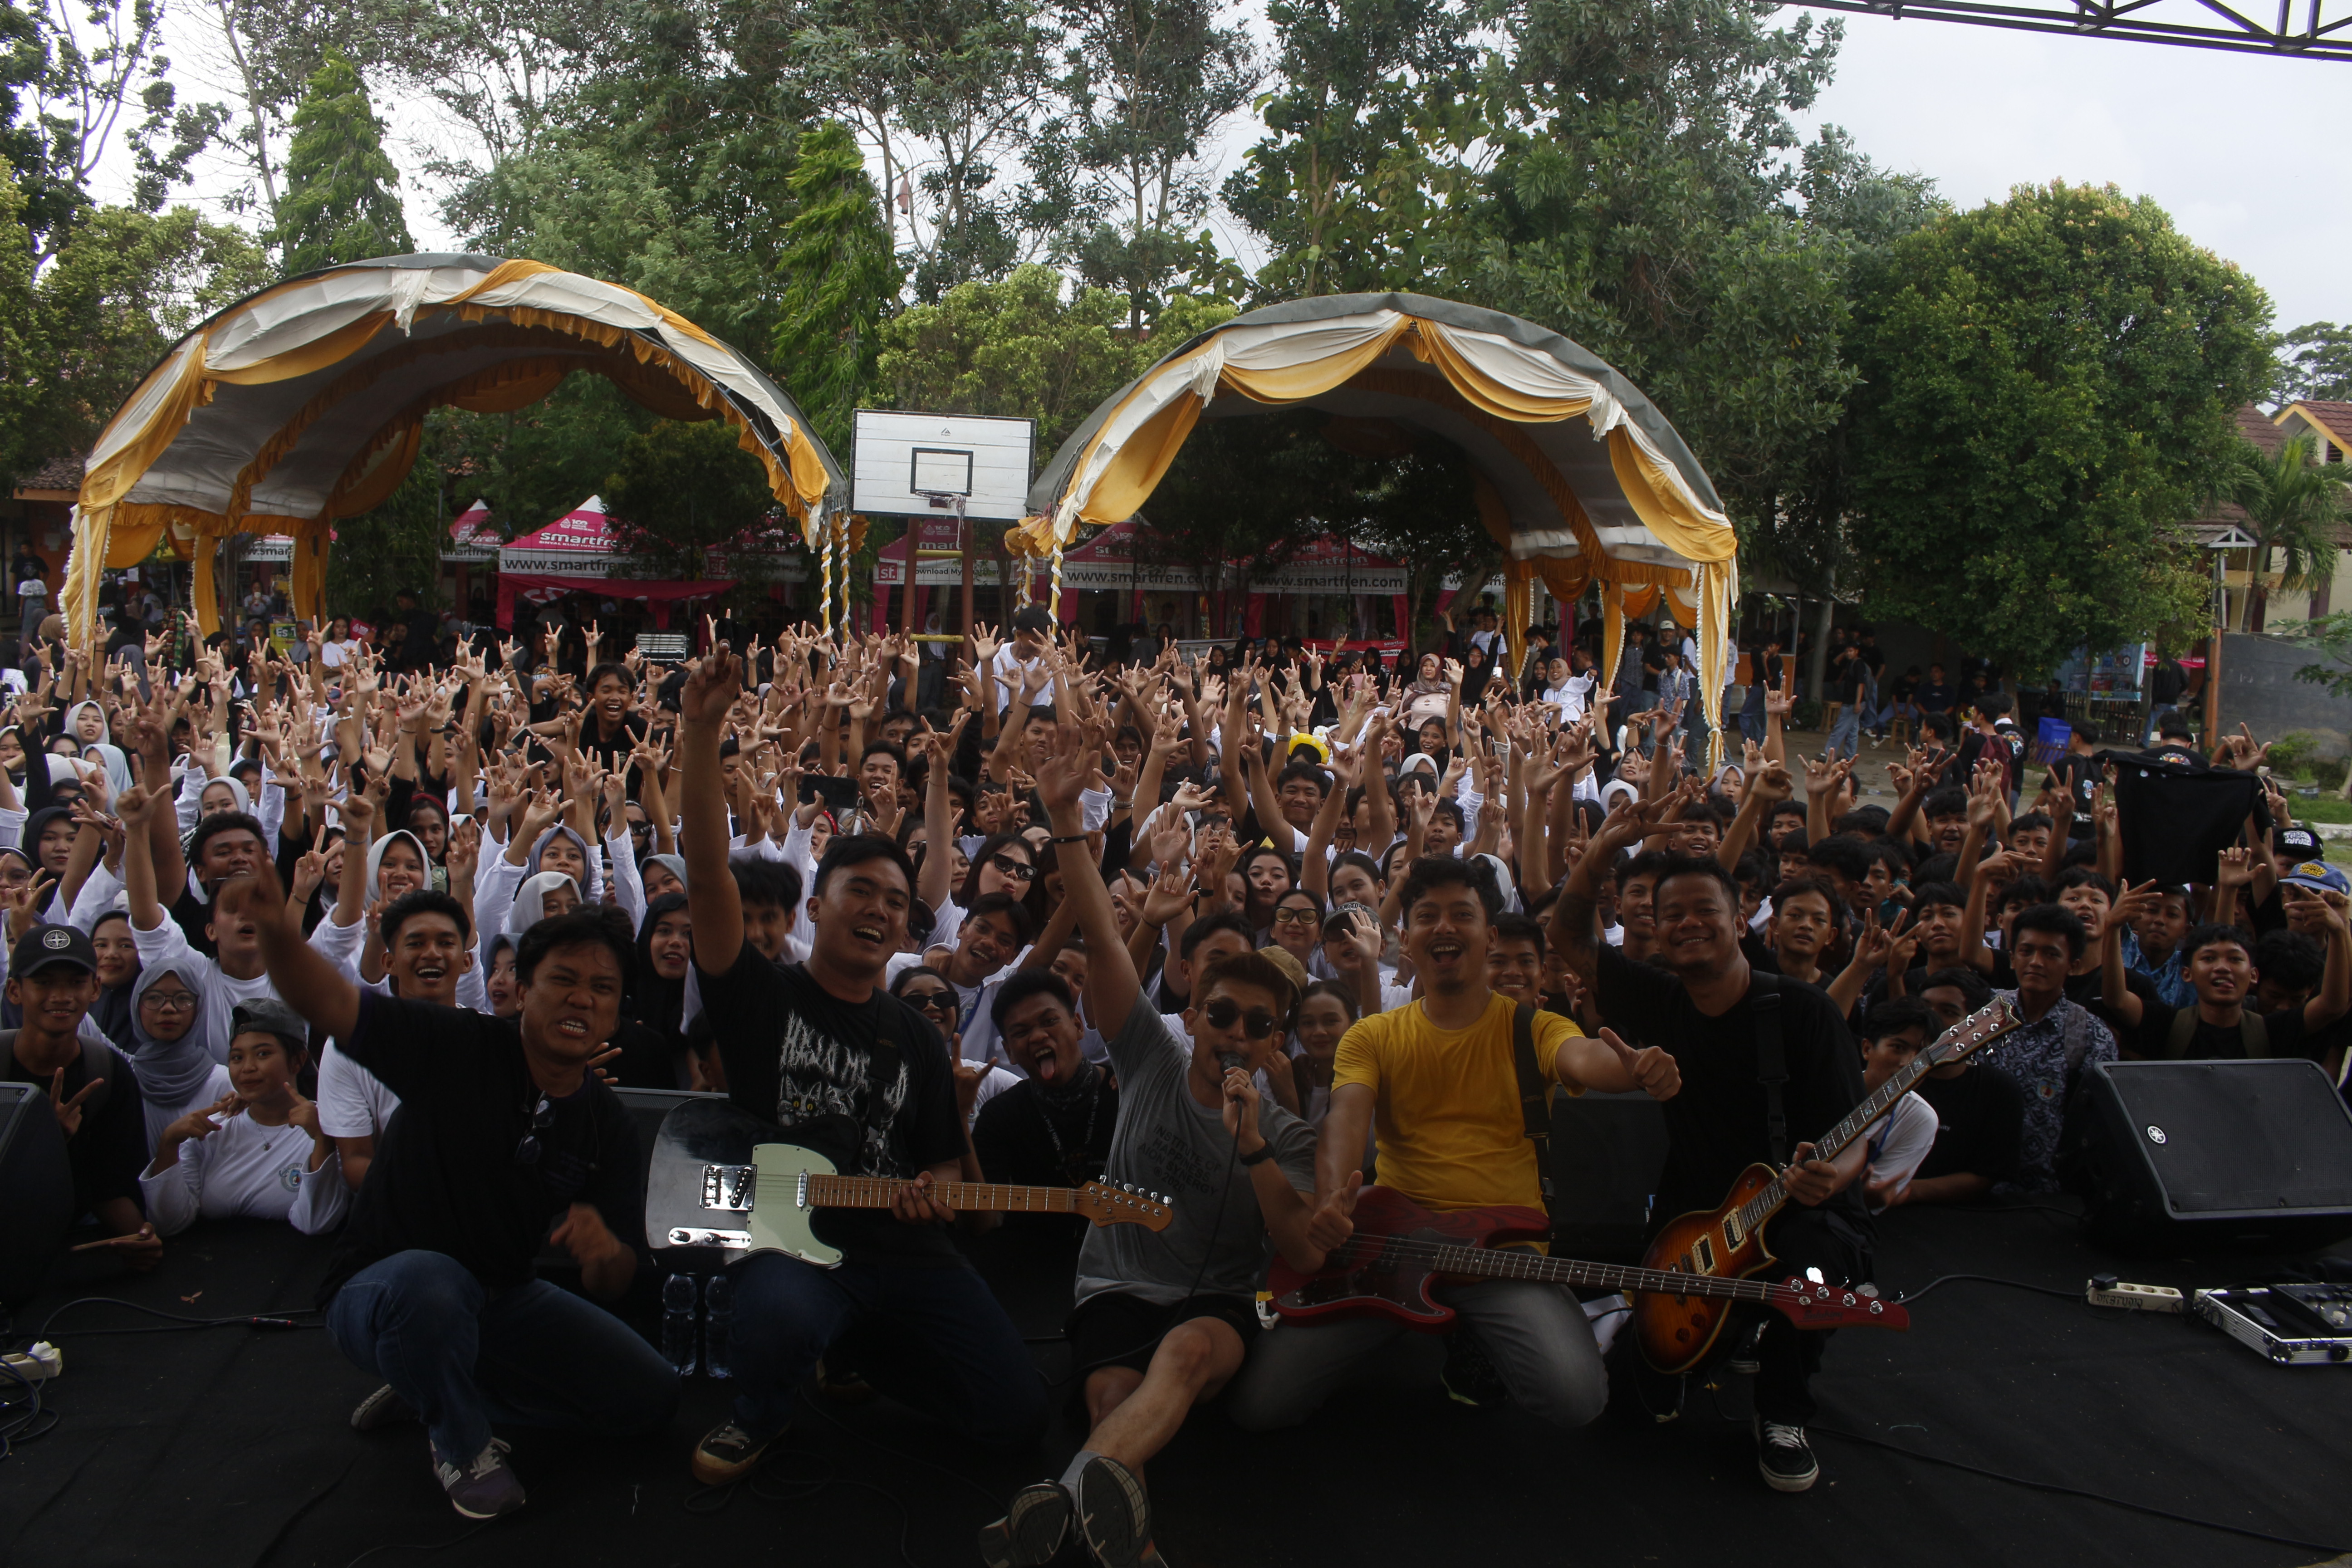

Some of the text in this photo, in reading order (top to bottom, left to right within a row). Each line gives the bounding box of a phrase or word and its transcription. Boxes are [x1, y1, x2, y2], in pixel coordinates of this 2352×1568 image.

[1137, 1143, 1220, 1196] AION SYNERGY
[1153, 1138, 1210, 1182] HAPPINESS
